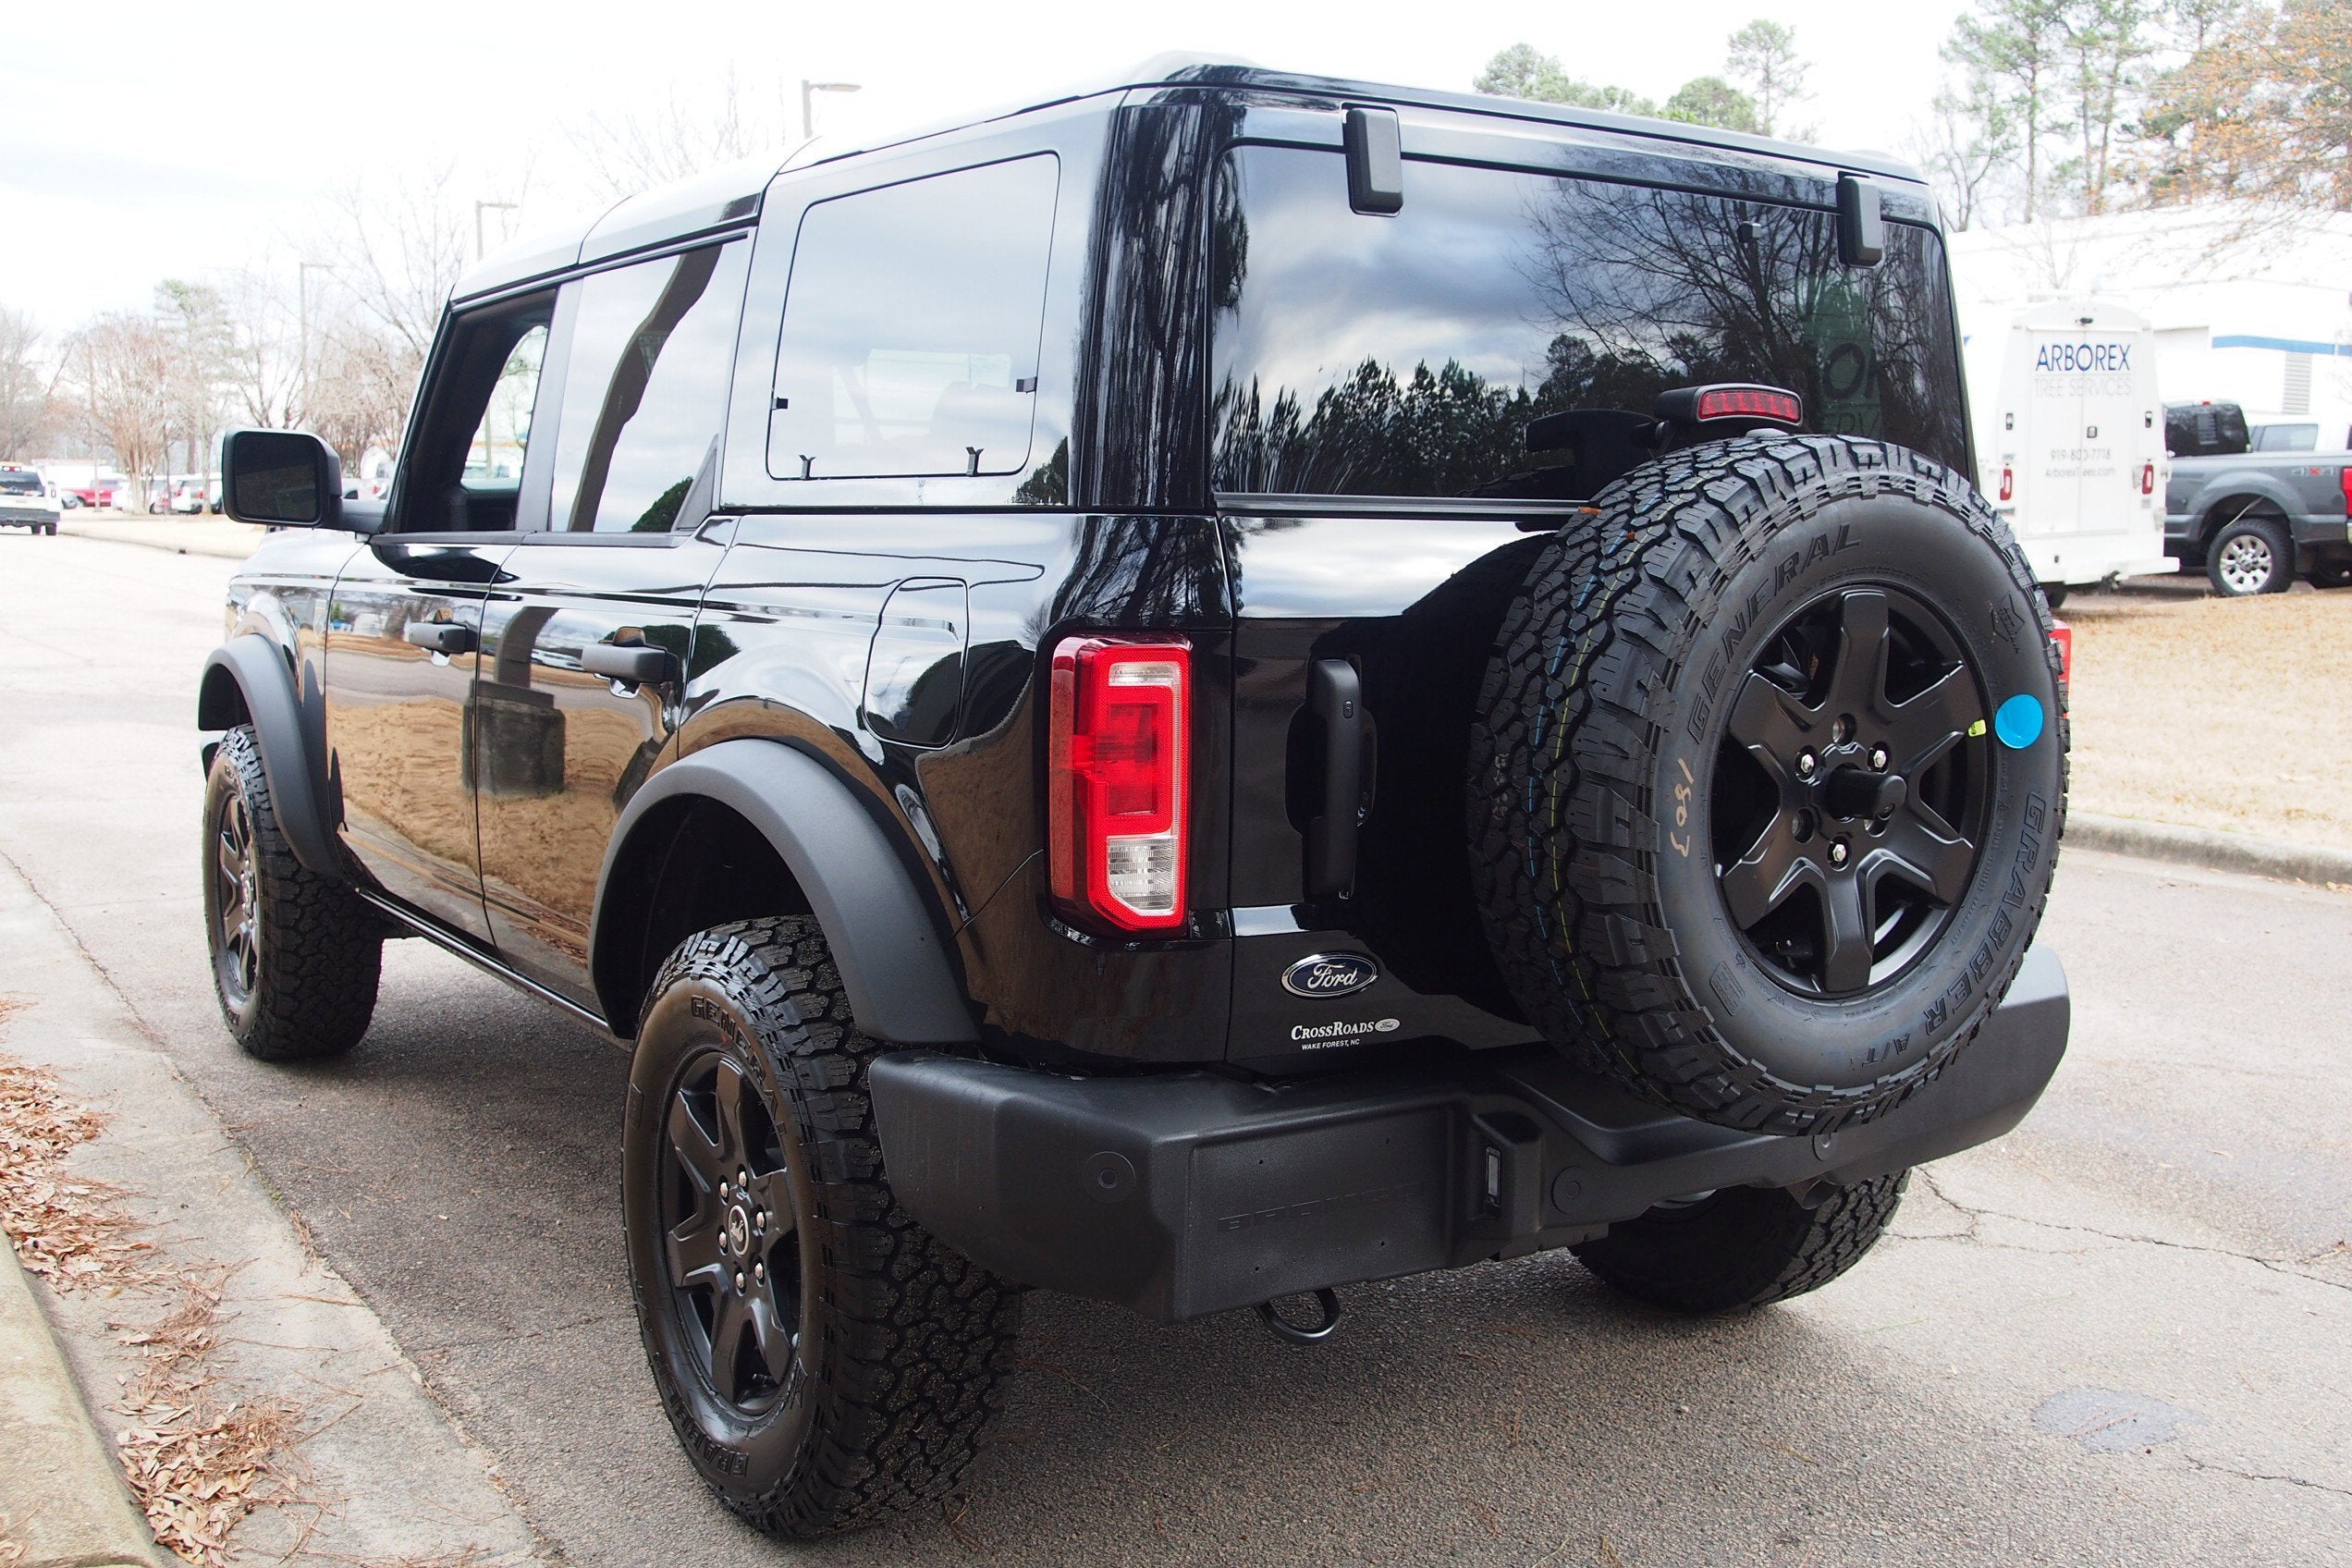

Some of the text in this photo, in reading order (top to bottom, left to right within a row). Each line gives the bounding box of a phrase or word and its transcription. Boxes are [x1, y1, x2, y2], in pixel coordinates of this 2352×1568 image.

[2035, 343, 2131, 372] ARBOREX
[2035, 377, 2131, 397] TREE SERVICES
[1687, 522, 1861, 744] GENERAL
[1923, 790, 2047, 1035] GRABBER
[1306, 962, 1358, 989] Ford
[1301, 1042, 1321, 1051] WAKE
[1322, 1039, 1350, 1048] FOREST,
